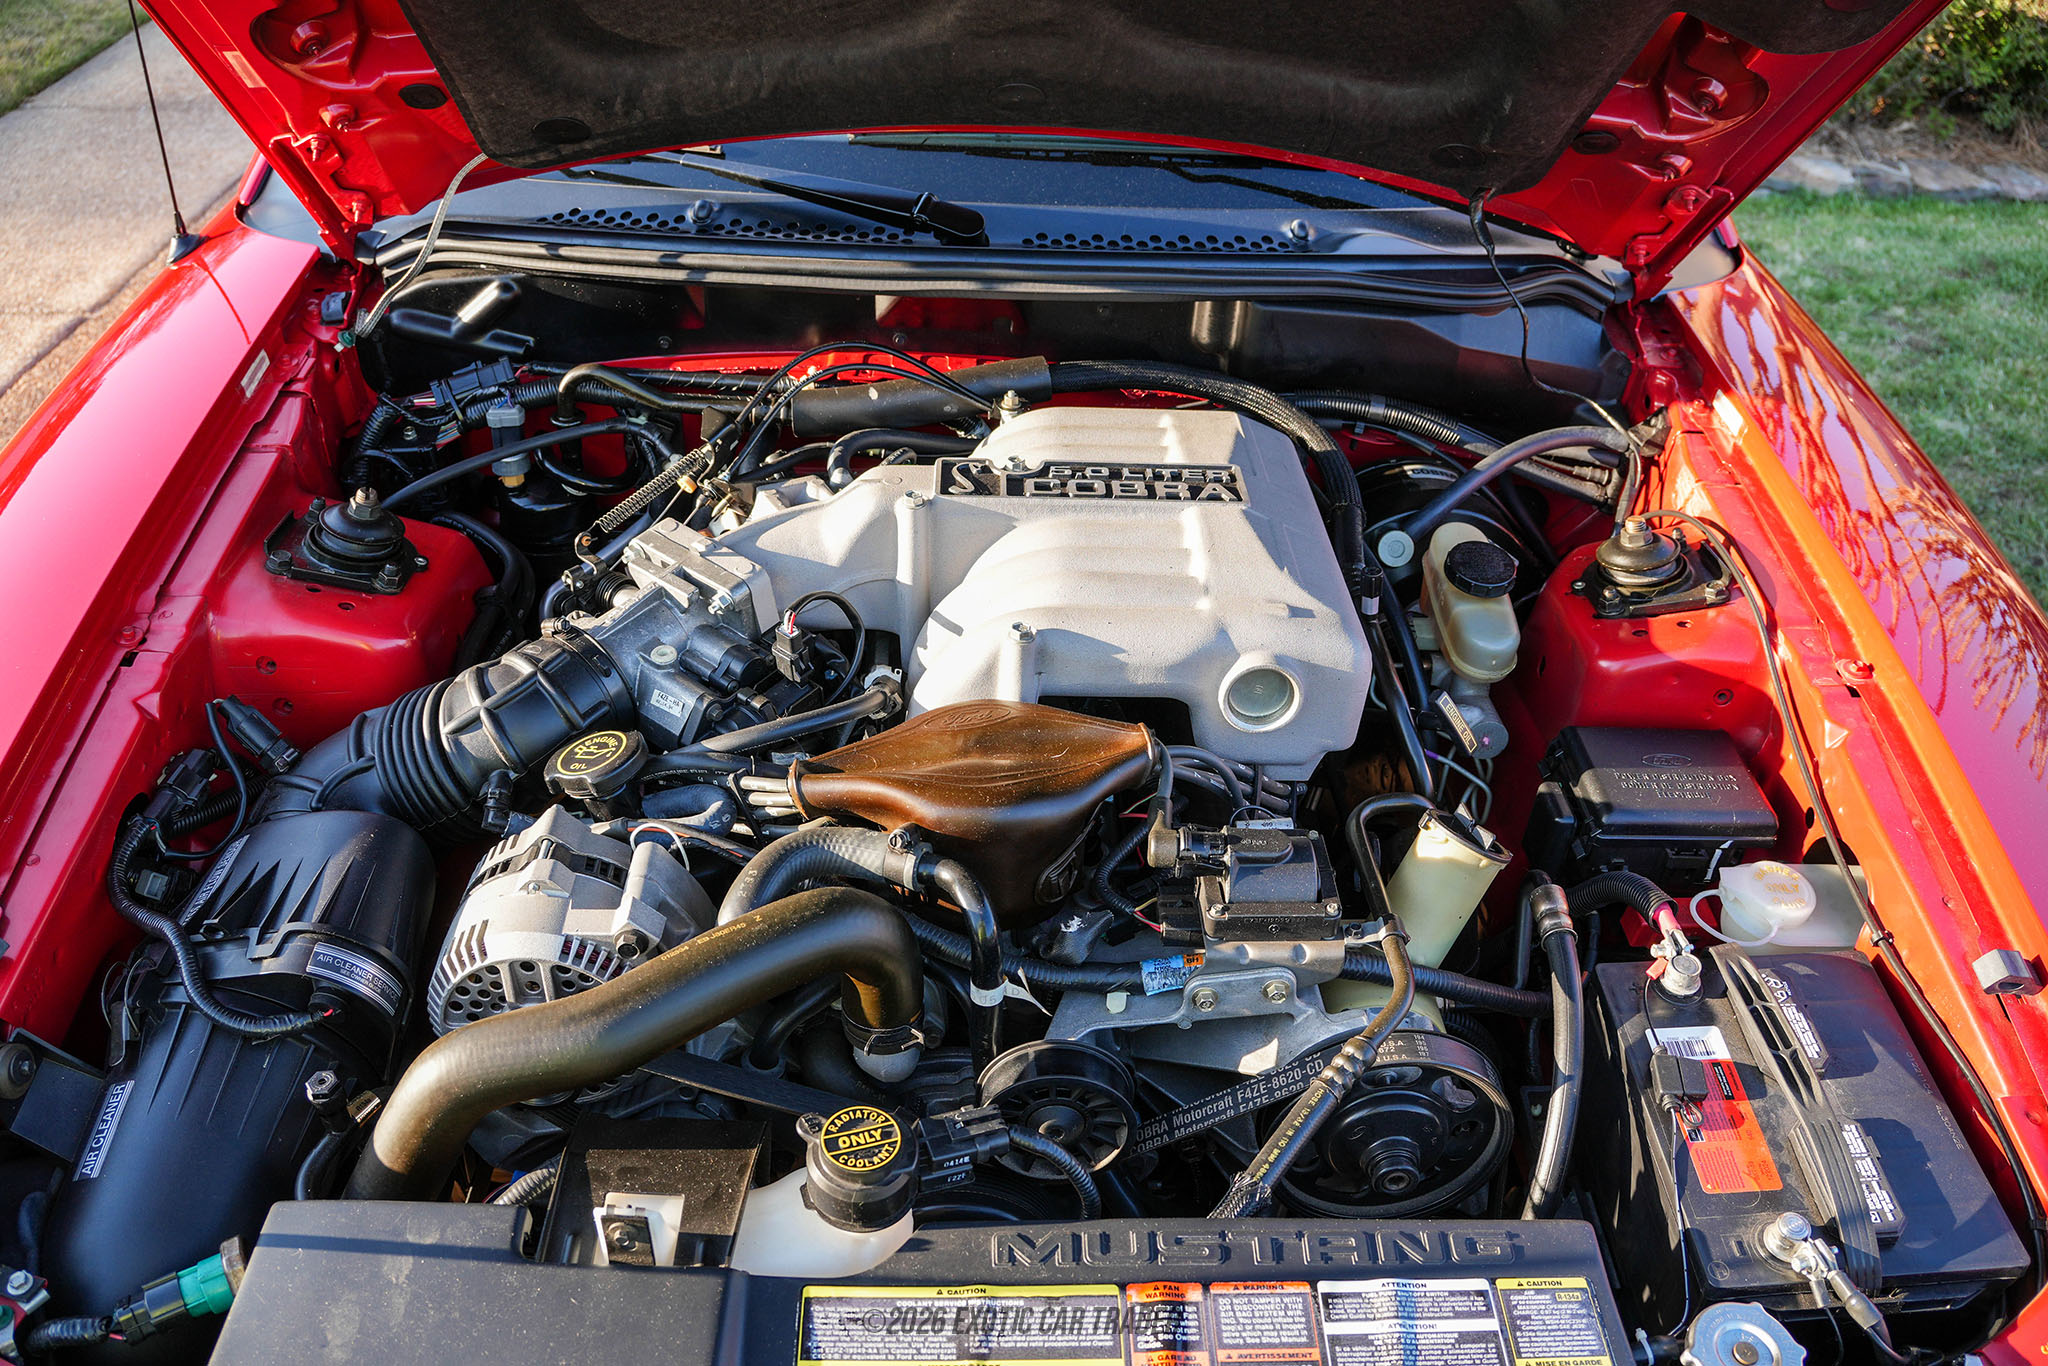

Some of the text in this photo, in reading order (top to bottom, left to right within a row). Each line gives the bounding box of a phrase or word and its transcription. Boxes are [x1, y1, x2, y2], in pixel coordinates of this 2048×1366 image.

[1049, 465, 1231, 483] 5.0 LITER
[1025, 478, 1243, 501] COBRA
[1445, 703, 1465, 732] ENGINE
[585, 736, 618, 748] ENGINE
[570, 762, 588, 770] OIL
[317, 953, 400, 1001] AIR CLEANER SERVICE
[1136, 1120, 1169, 1142] OBRA
[1172, 1098, 1234, 1128] Motorcraft
[1237, 1059, 1324, 1103] F4ZE-8620-CD
[1310, 1088, 1325, 1107] HOSE
[80, 1084, 126, 1175] AIR CLEANER
[828, 1109, 886, 1133] RADIATOR
[838, 1128, 883, 1150] ONLY
[838, 1143, 895, 1168] COOLANT
[990, 1229, 1523, 1268] MUSTANG
[1145, 1291, 1186, 1299] WARNING
